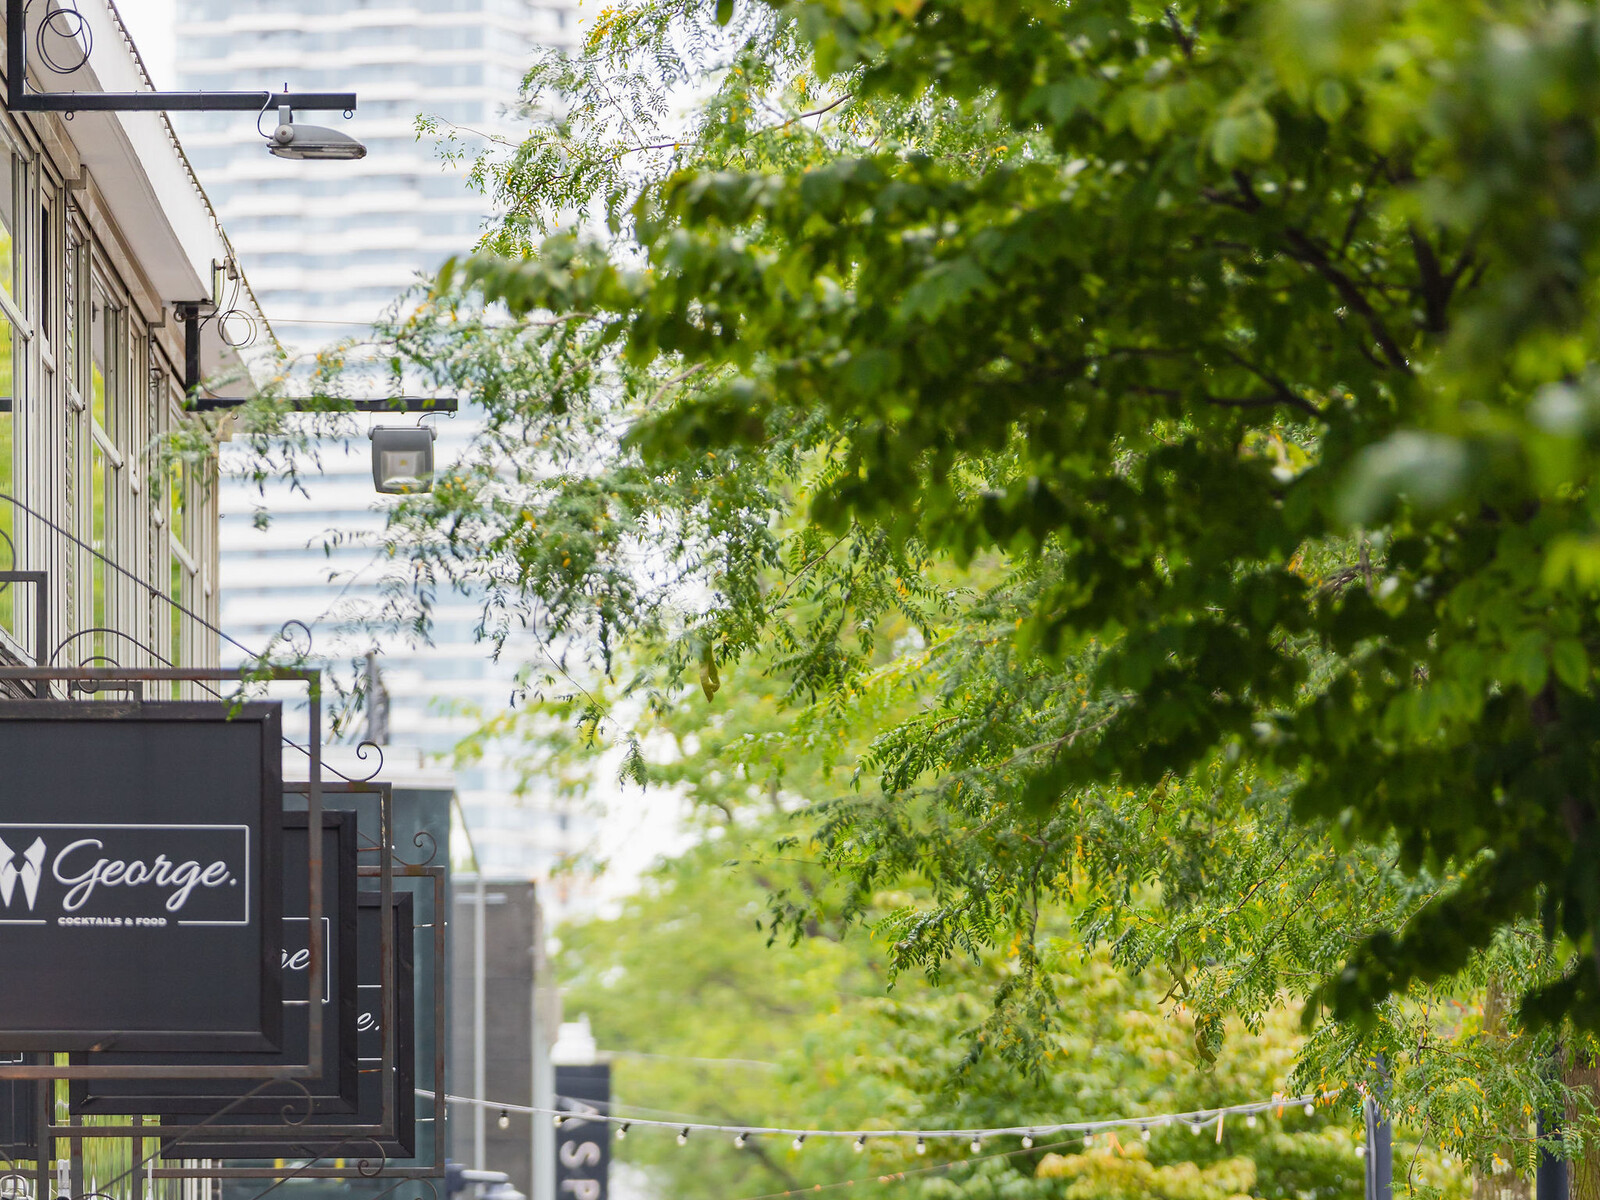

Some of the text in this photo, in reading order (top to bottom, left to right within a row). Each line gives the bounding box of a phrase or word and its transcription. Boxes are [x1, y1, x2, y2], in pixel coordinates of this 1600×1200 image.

[52, 838, 237, 912] George.
[57, 916, 167, 927] COCKTAILS & FOOD
